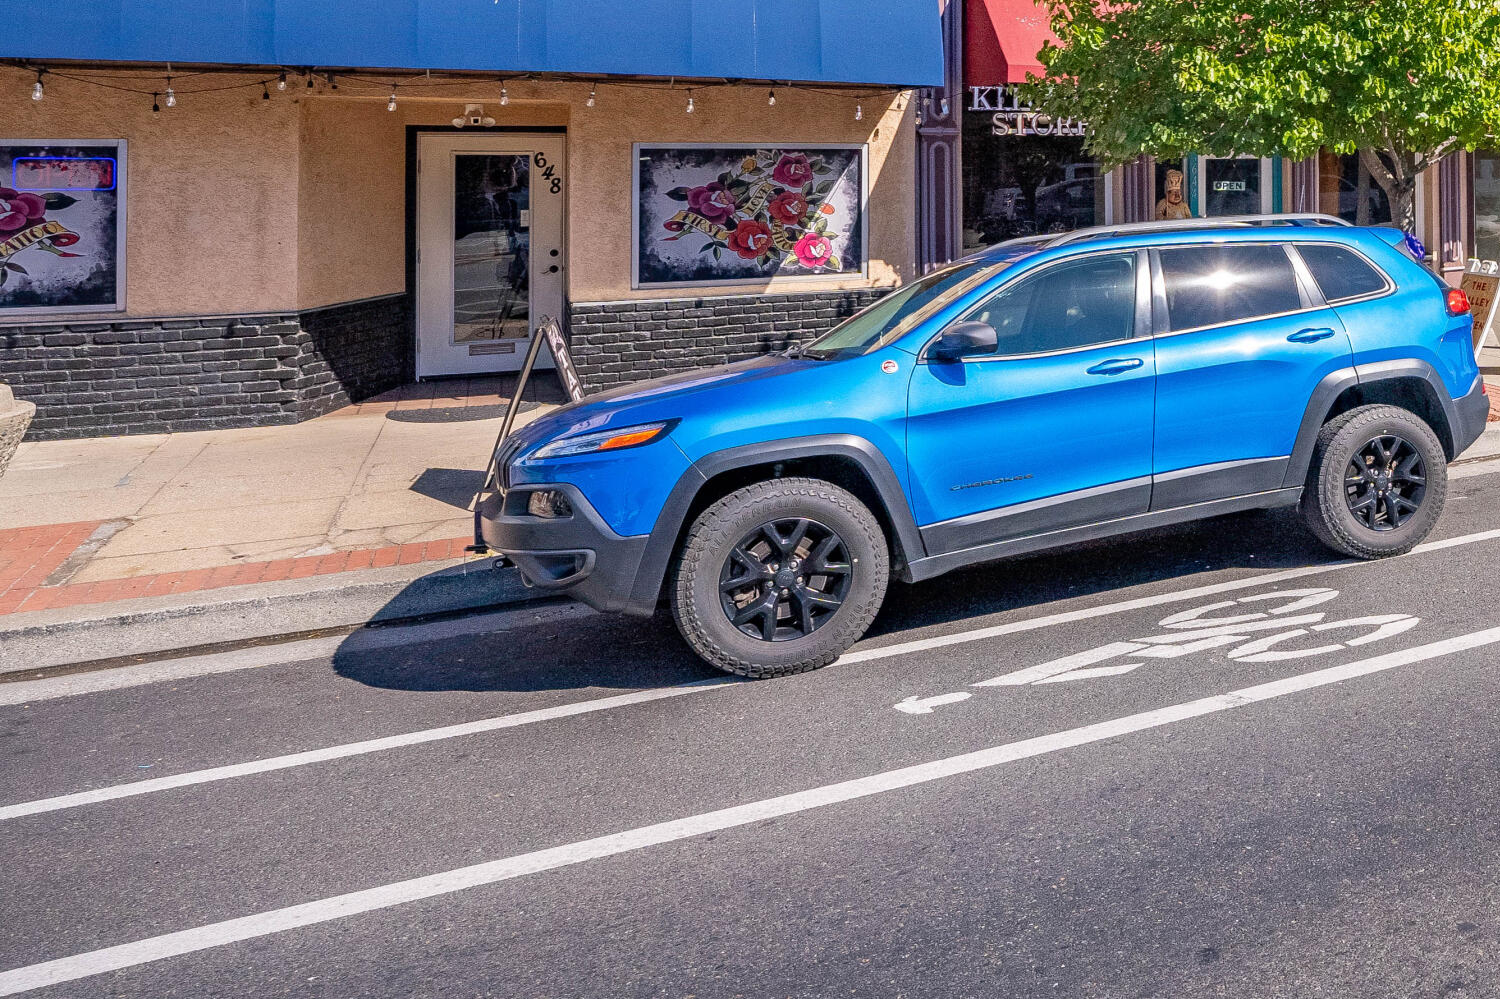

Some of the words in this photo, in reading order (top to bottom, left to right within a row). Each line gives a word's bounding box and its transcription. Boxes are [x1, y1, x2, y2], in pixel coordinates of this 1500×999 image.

[534, 151, 561, 194] 648
[1215, 181, 1243, 190] OPEN
[683, 212, 720, 238] FIRST
[1472, 281, 1487, 291] THE
